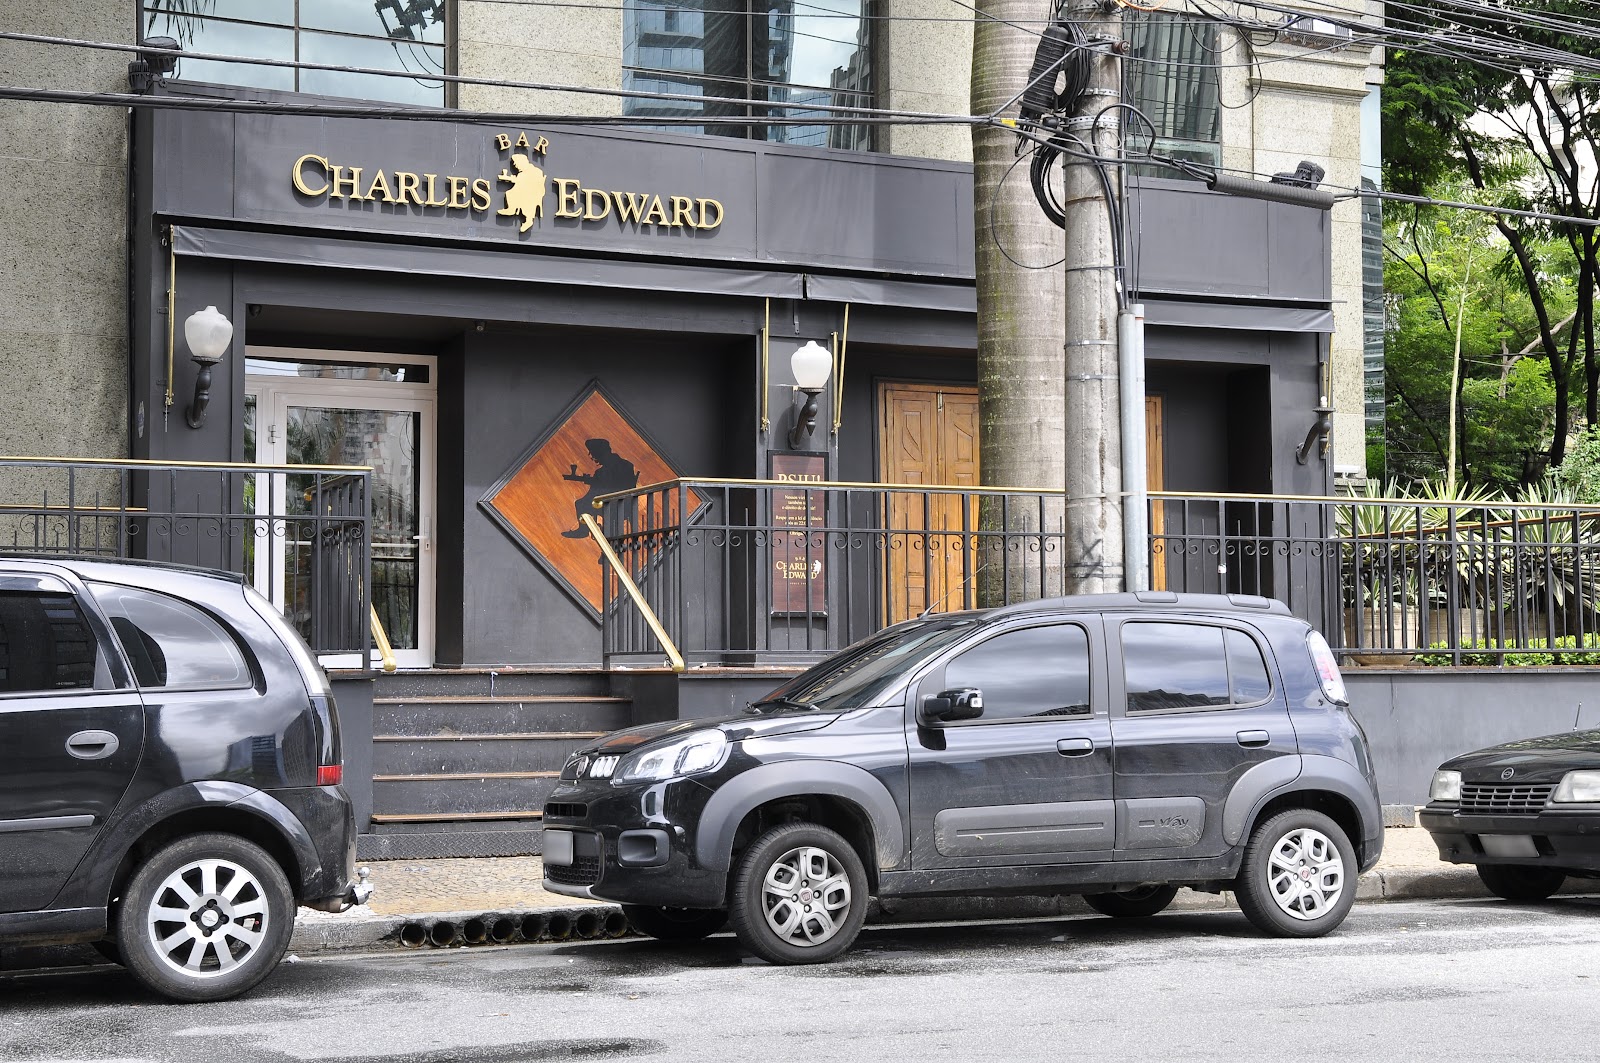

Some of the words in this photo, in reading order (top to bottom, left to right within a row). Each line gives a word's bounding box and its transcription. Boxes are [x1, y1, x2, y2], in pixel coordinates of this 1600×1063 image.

[495, 131, 550, 155] BAR
[292, 153, 492, 212] CHARLES
[552, 177, 725, 229] EDWARD
[782, 569, 818, 579] EDWAD
